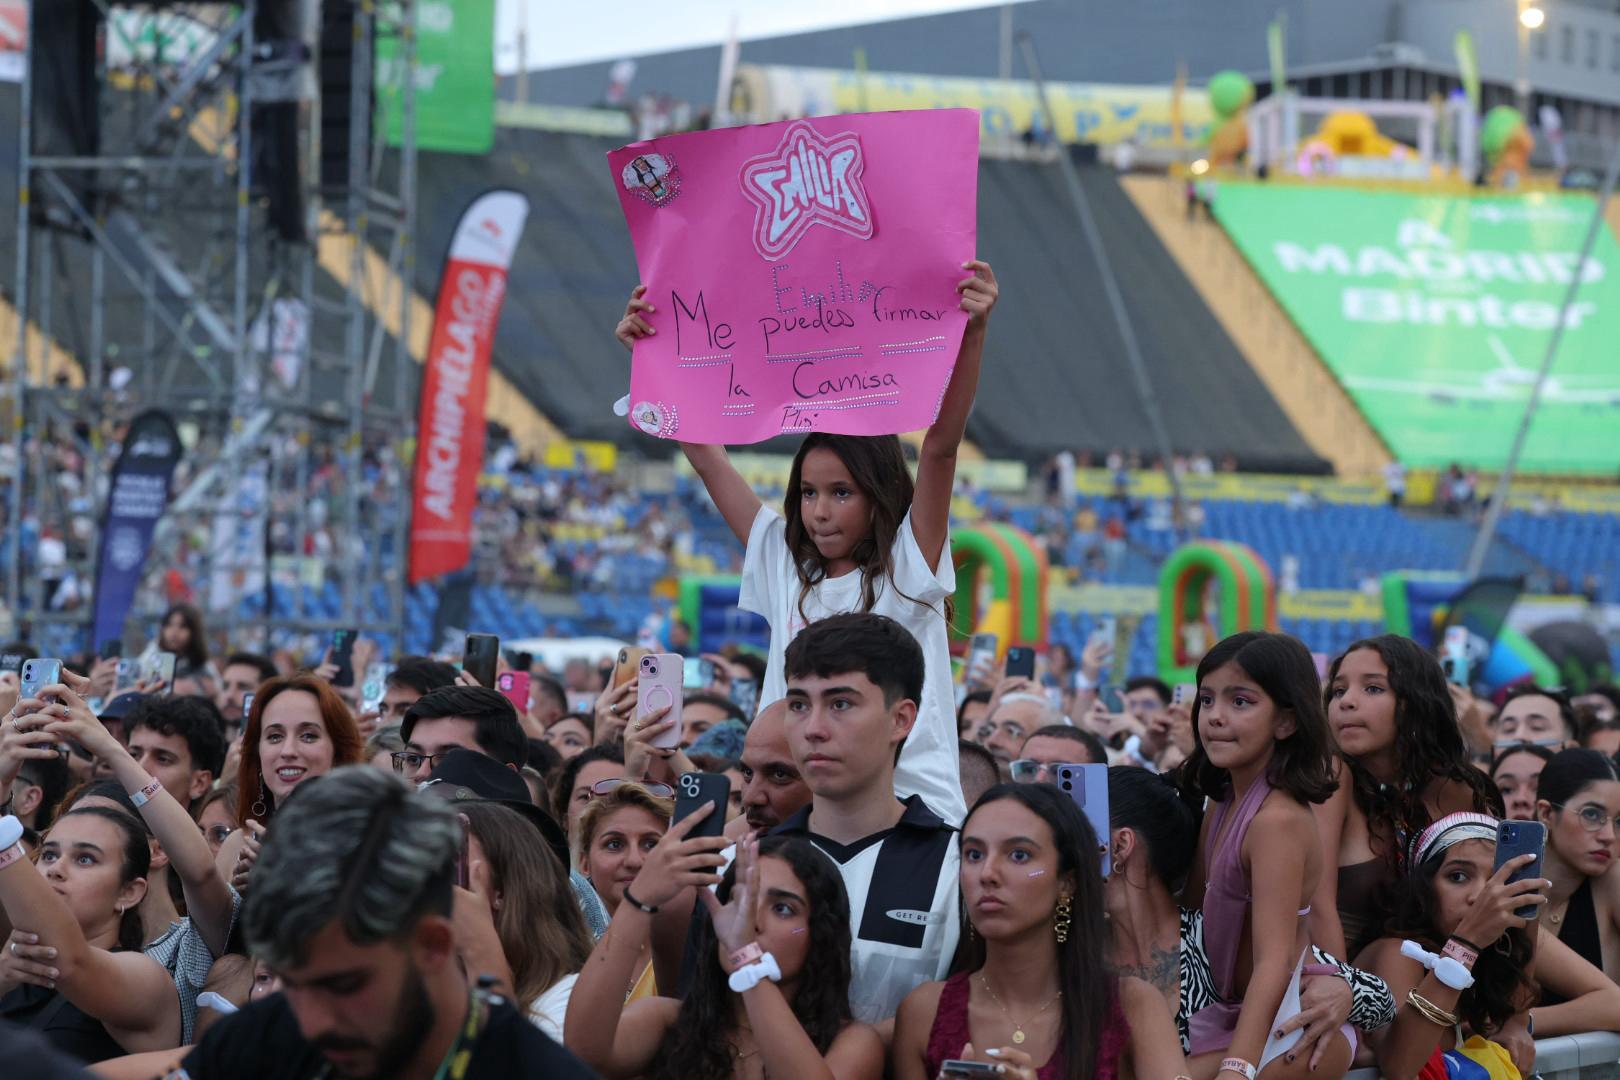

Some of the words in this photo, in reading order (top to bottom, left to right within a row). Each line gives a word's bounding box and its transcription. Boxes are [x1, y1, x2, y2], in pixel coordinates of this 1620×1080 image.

[754, 138, 866, 243] EMILIA
[671, 289, 737, 356] Me
[757, 299, 856, 355] puedes
[873, 285, 948, 323] firmar
[1341, 287, 1598, 329] Binter
[422, 268, 486, 520] ARCHIPIÉLAGO
[728, 362, 750, 398] la
[792, 361, 898, 399] Camisa
[895, 911, 913, 919] GET
